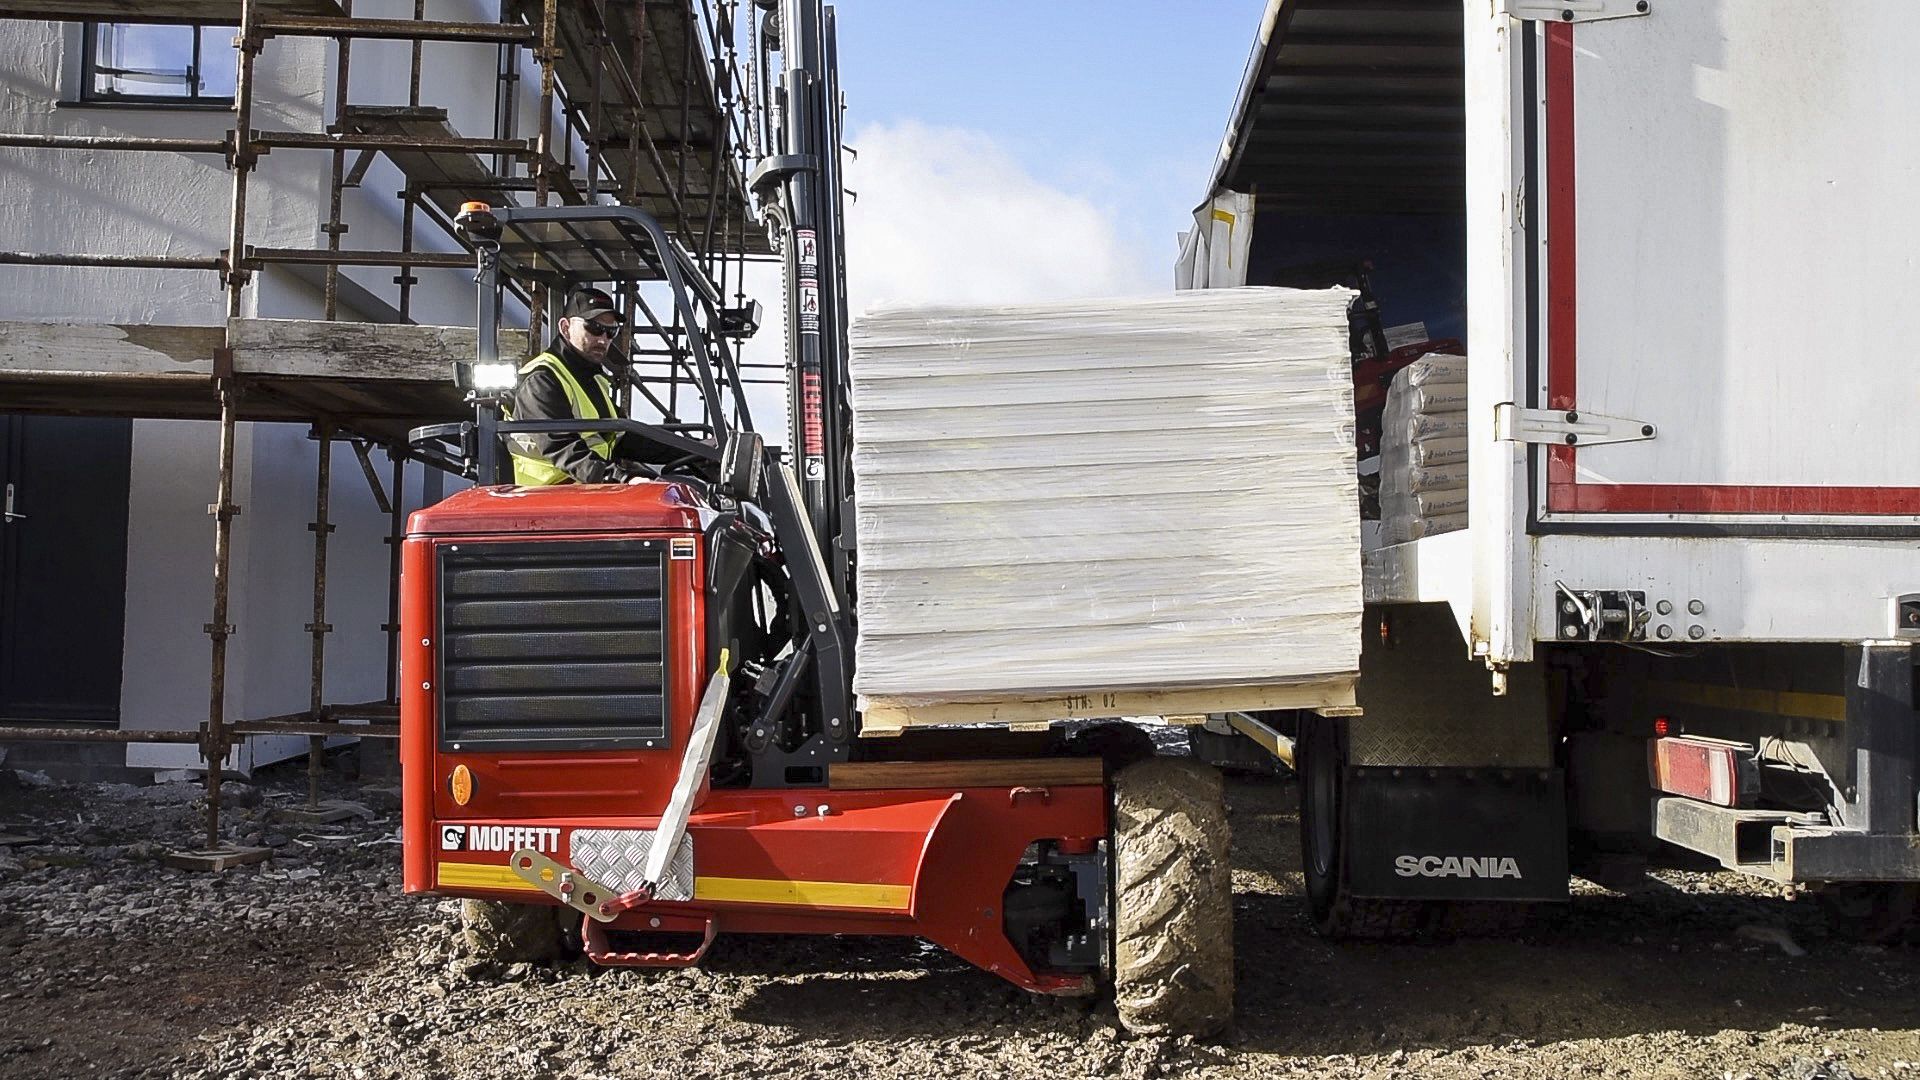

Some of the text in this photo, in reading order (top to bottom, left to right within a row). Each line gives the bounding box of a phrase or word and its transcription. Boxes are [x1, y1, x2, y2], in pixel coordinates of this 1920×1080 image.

[803, 371, 823, 454] MOFFETT
[469, 825, 560, 853] MOFFETT
[1394, 855, 1522, 879] SCANIA
